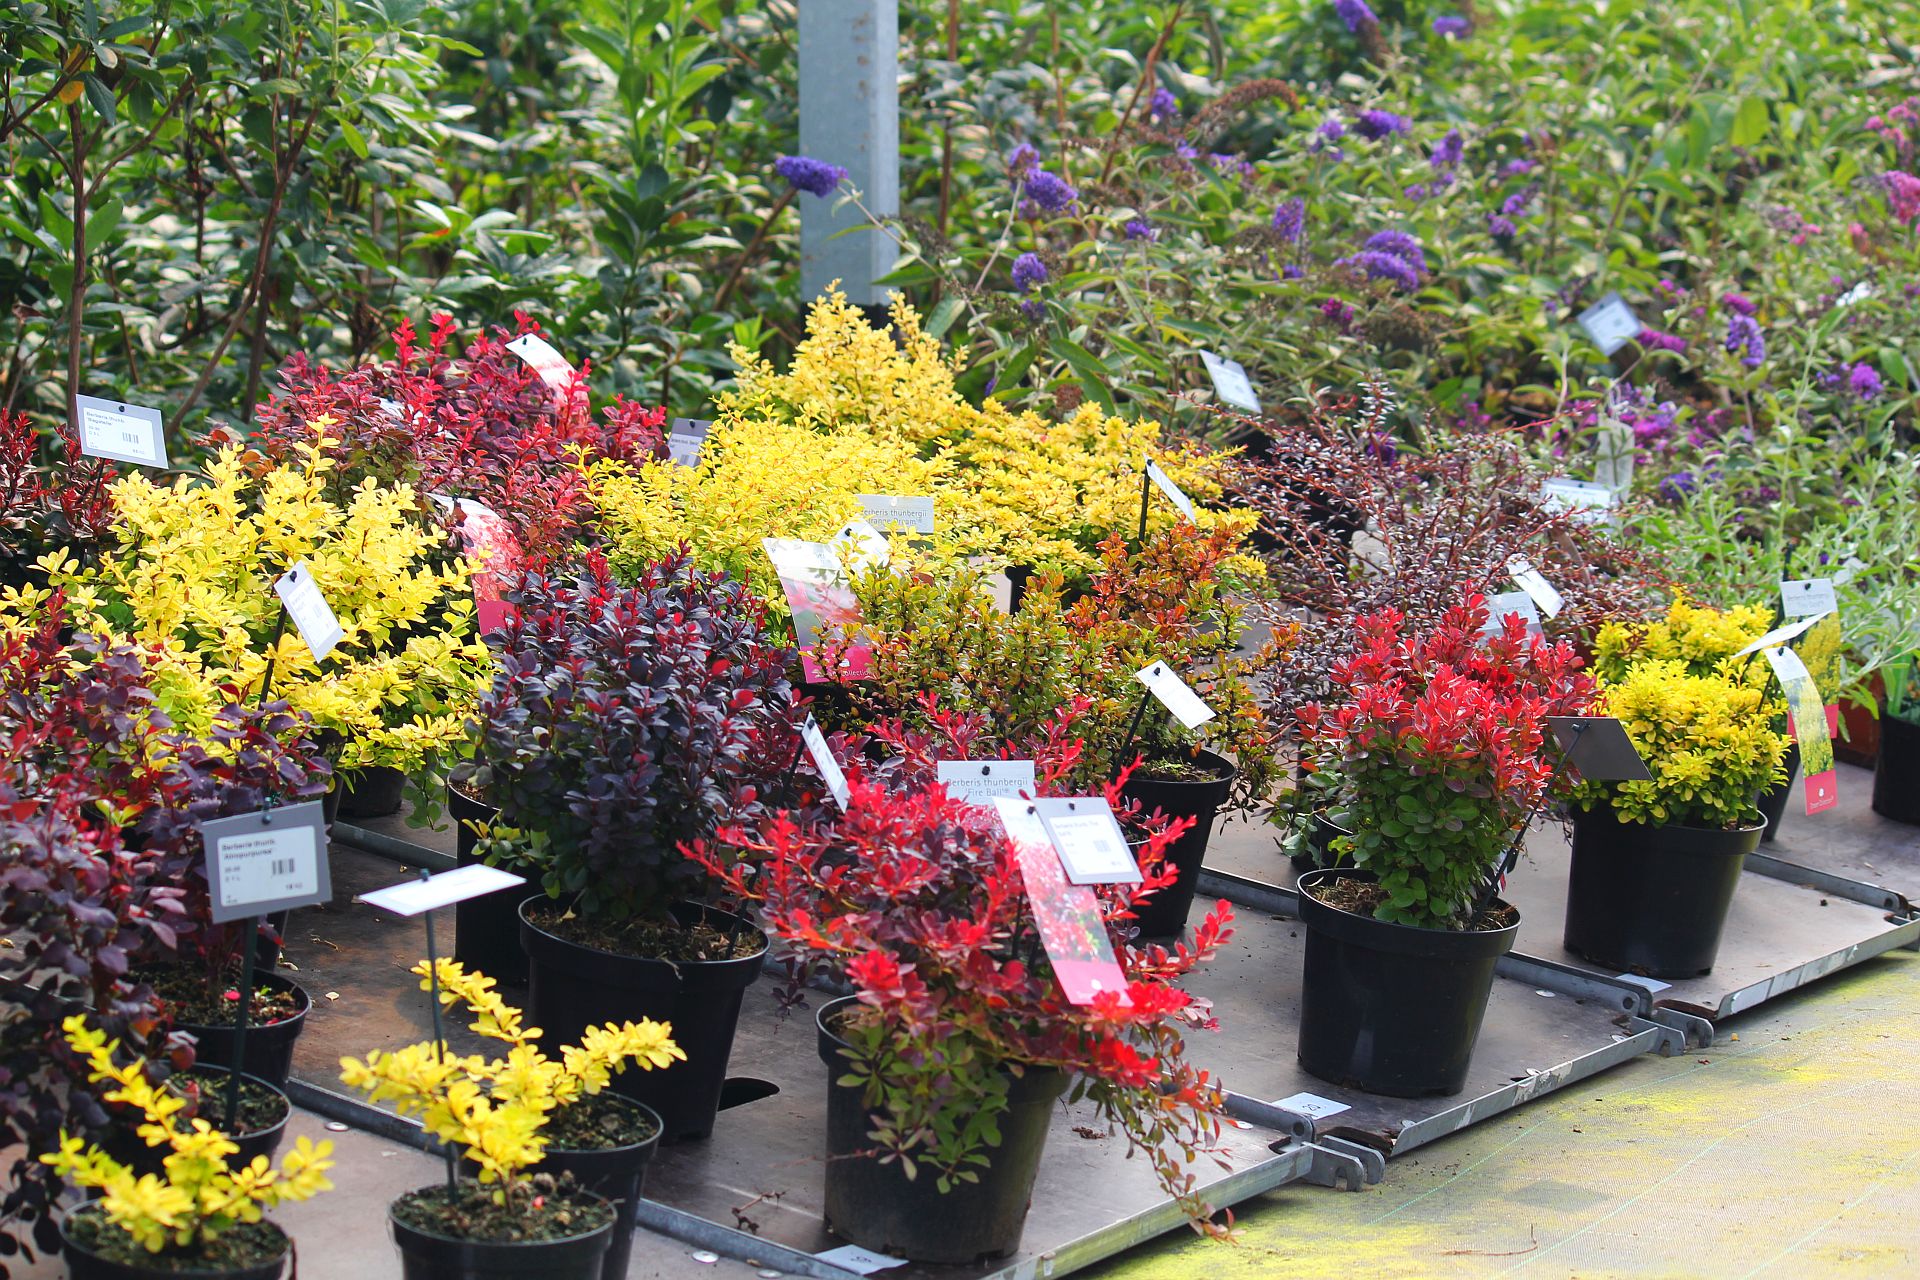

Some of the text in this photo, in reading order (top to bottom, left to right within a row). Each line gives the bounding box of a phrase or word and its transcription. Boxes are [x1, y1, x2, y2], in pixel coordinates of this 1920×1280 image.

[890, 509, 927, 518] thunbergii
[947, 777, 1028, 787] Berberis thunbergii
